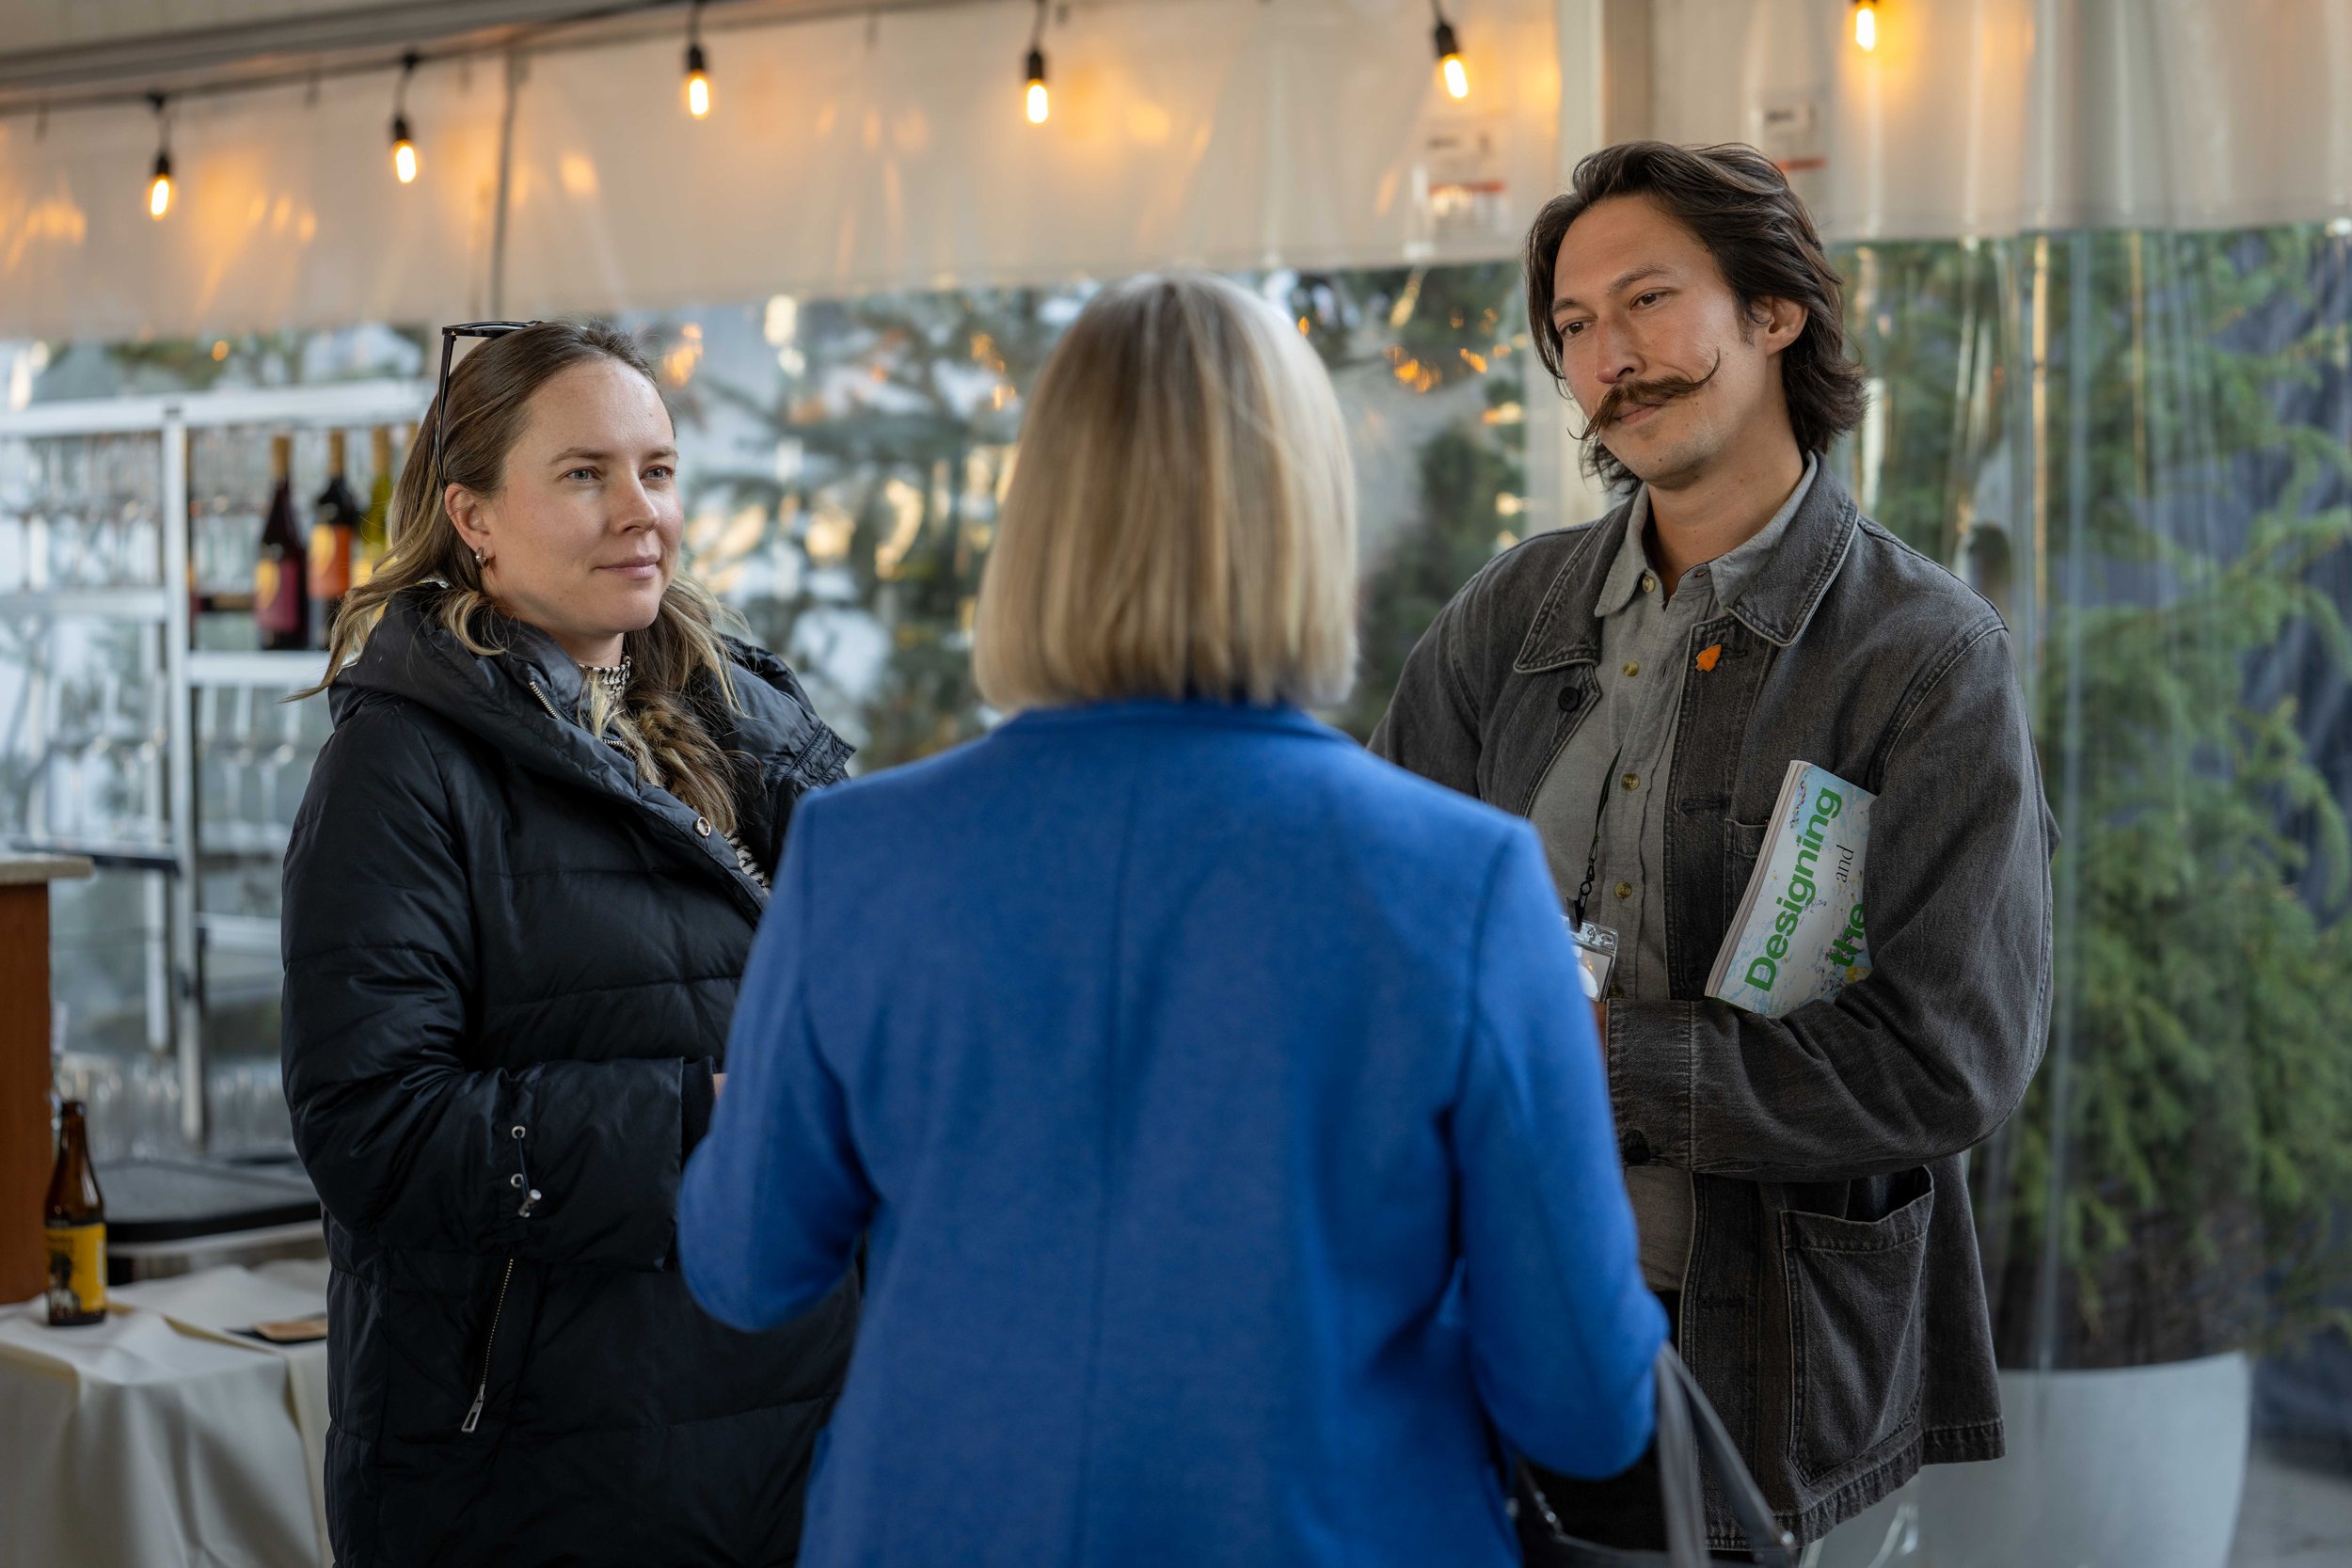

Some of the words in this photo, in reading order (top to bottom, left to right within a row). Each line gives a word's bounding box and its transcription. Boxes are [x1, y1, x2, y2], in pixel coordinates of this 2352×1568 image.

[1744, 787, 1841, 991] Designing
[1836, 845, 1853, 882] and
[1829, 903, 1865, 967] the
